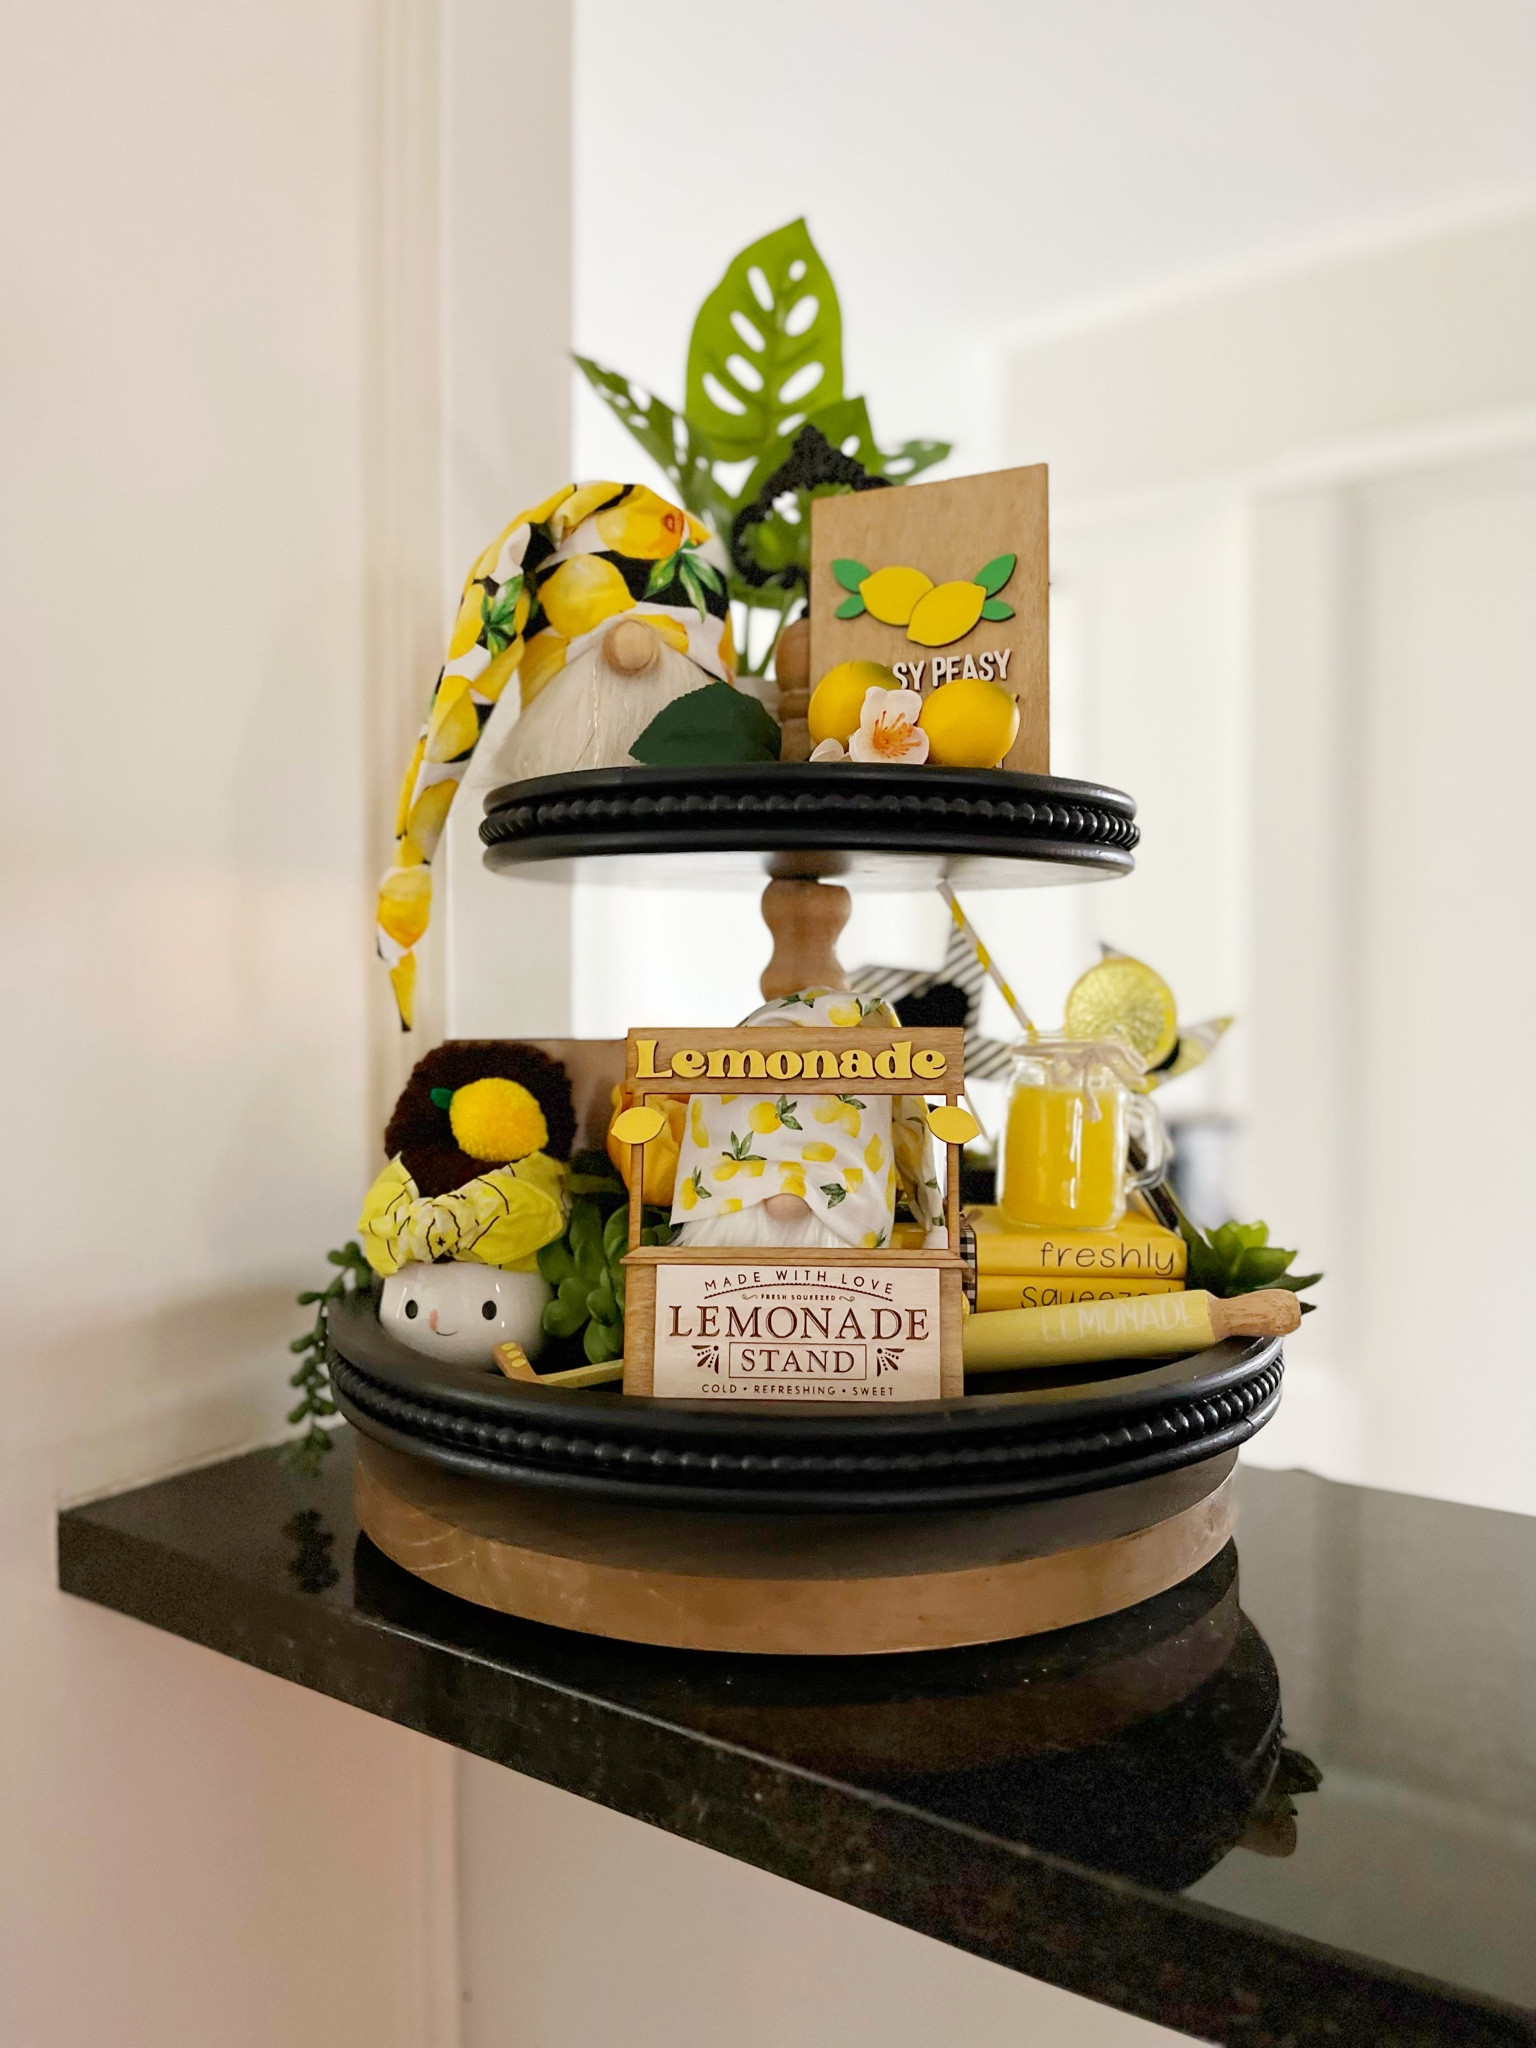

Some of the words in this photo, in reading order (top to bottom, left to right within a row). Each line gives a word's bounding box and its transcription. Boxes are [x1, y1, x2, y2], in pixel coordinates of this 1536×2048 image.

[893, 660, 925, 691] SY
[932, 648, 1011, 687] PEASY
[636, 1039, 947, 1080] Lemonade
[1040, 1241, 1174, 1276] freshly
[704, 1271, 761, 1291] MADE
[776, 1270, 826, 1282] WITH
[841, 1273, 893, 1294] LOVE
[669, 1305, 929, 1341] LEMONADE
[741, 1349, 855, 1373] STAND
[702, 1384, 737, 1394] COLD
[754, 1385, 836, 1396] REFRESHING
[852, 1387, 894, 1396] SWEET
